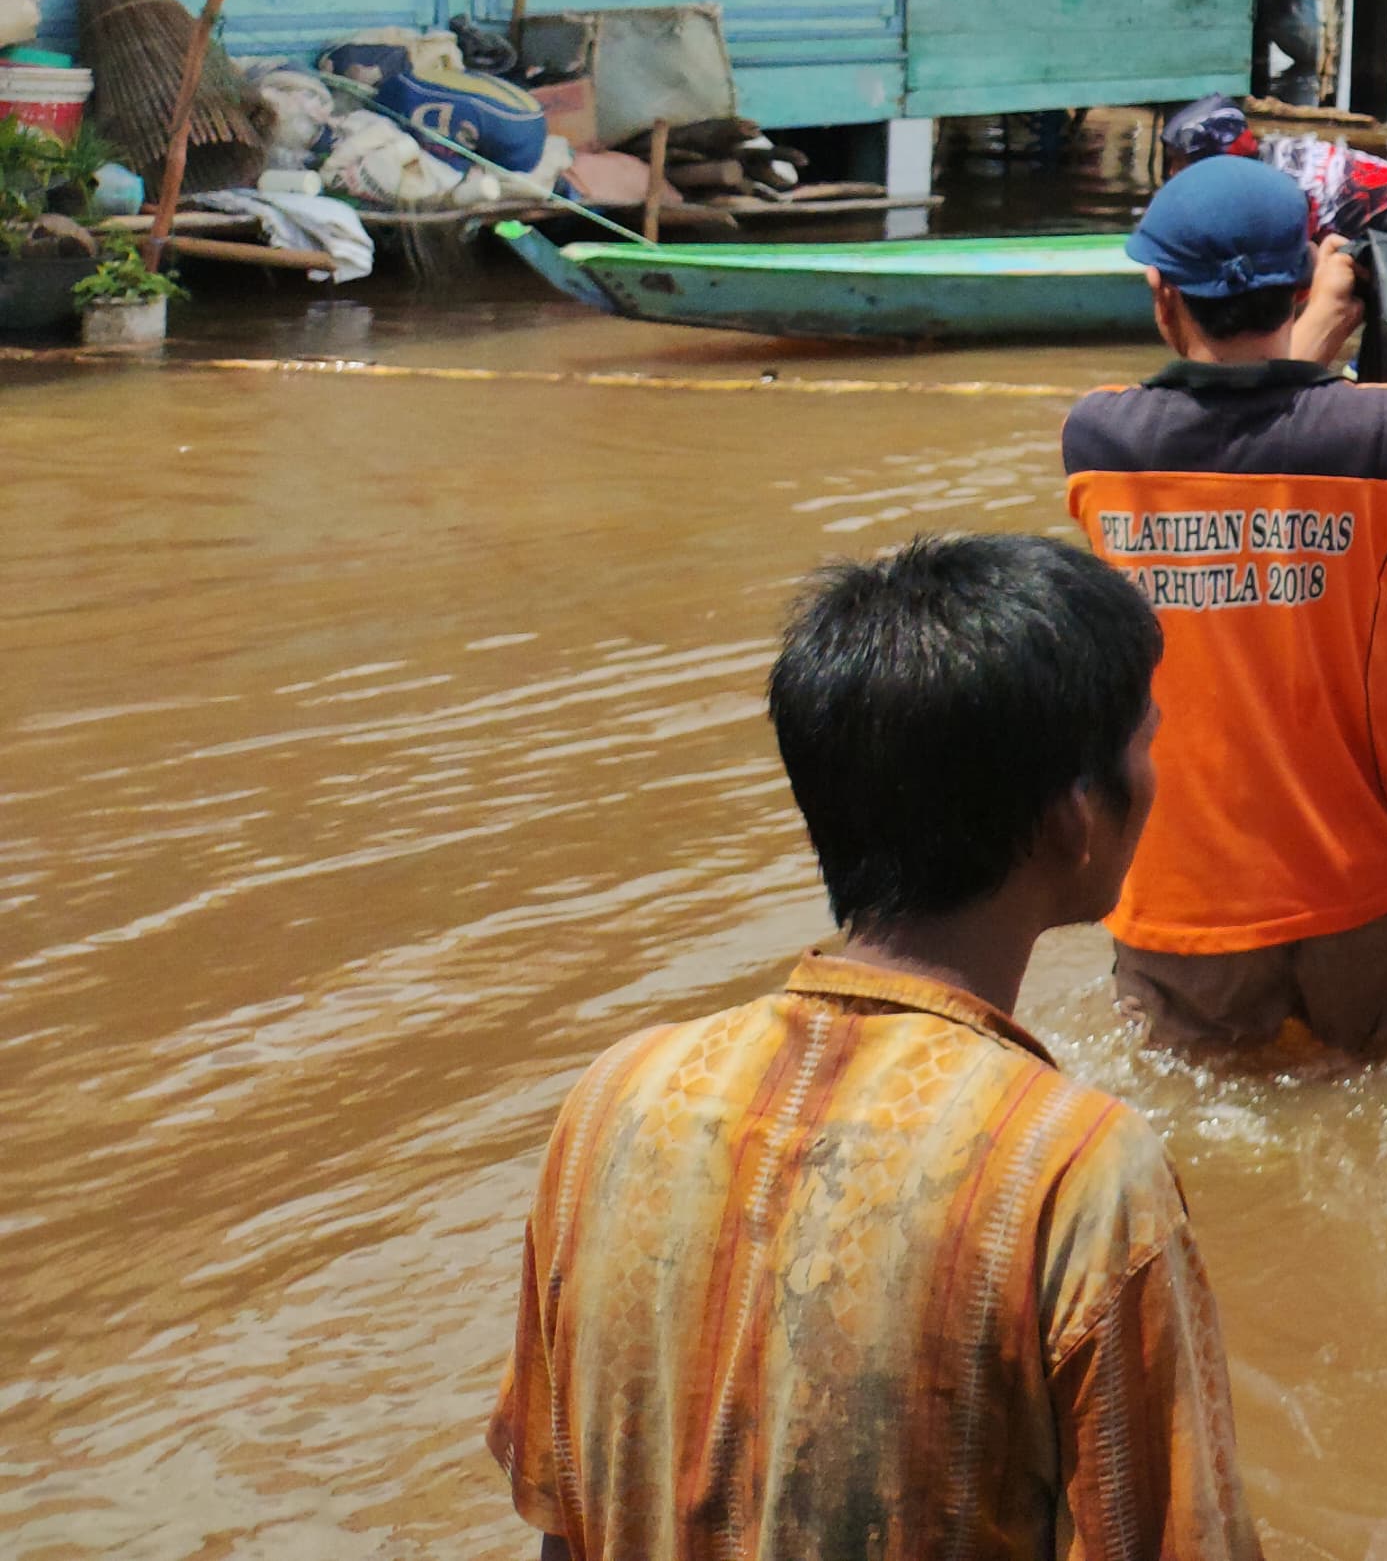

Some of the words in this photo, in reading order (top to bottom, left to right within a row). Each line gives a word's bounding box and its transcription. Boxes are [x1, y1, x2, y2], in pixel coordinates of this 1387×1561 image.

[1101, 515, 1243, 553] PELATIHAN
[1251, 513, 1353, 552] SATGAS
[1121, 567, 1260, 607] ARHUTLA
[1268, 564, 1325, 603] 2018
